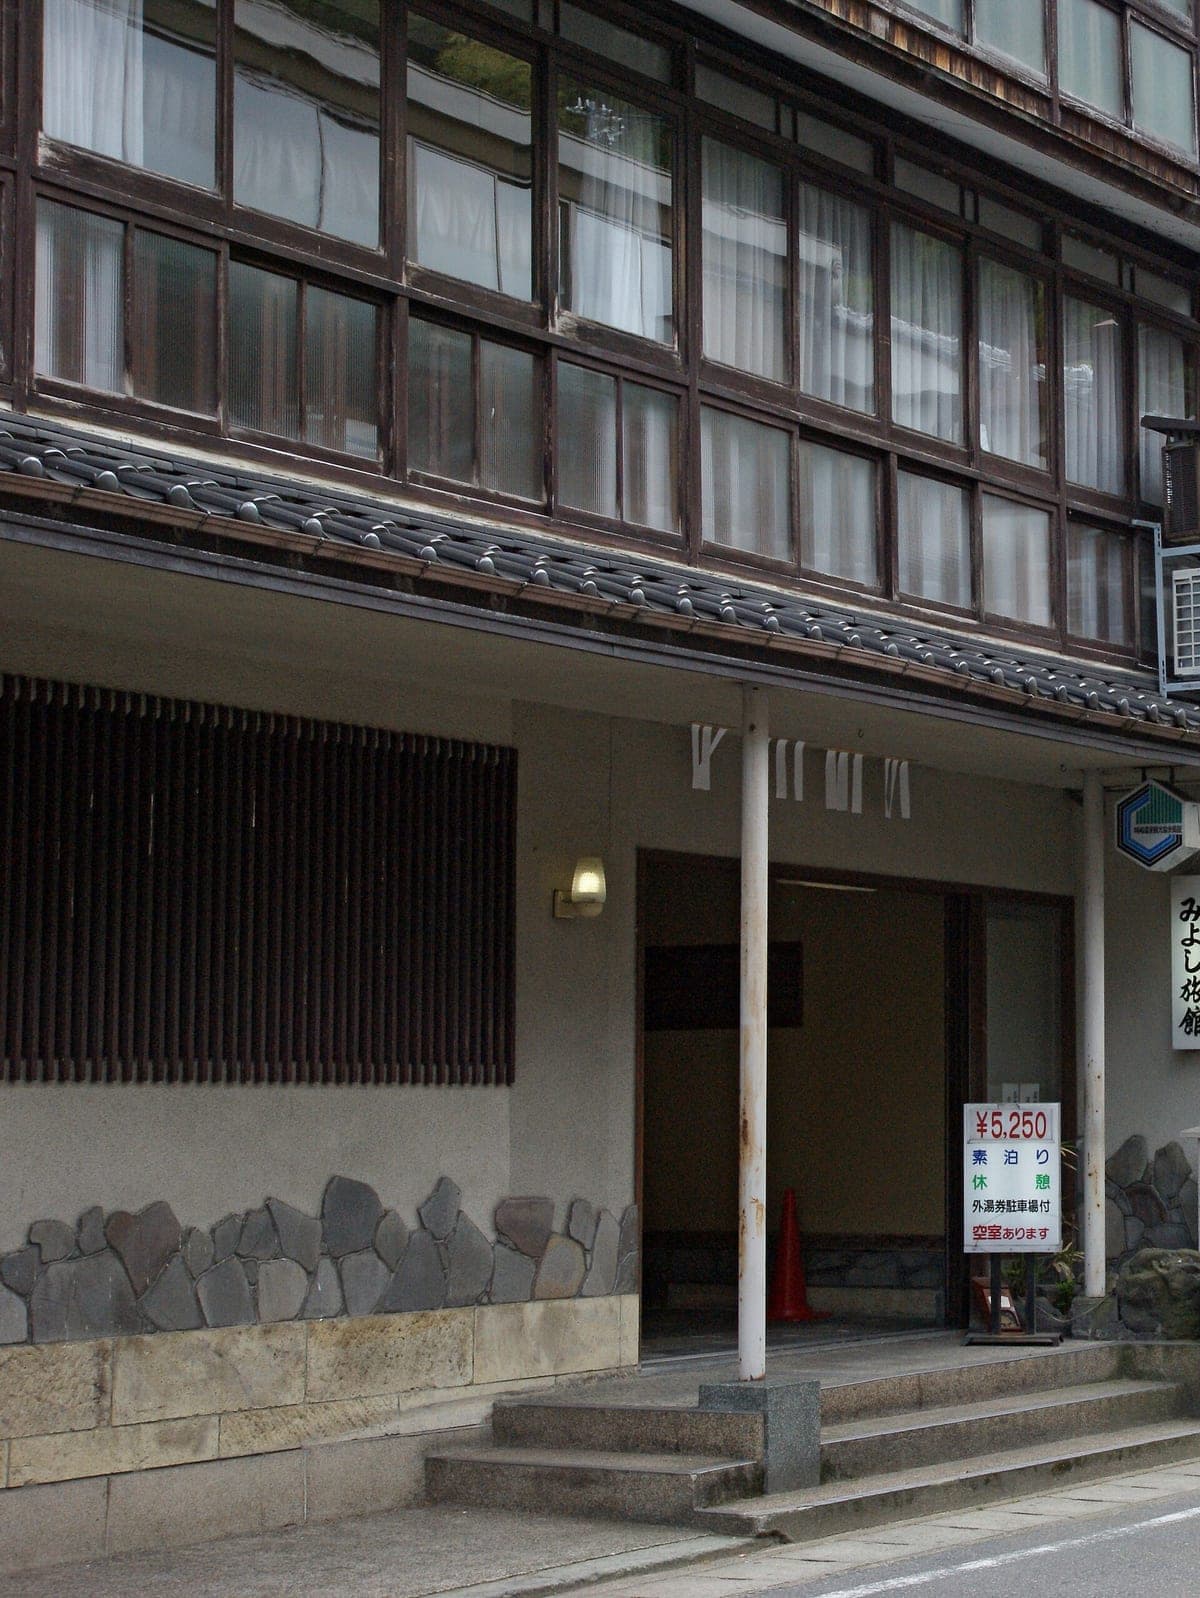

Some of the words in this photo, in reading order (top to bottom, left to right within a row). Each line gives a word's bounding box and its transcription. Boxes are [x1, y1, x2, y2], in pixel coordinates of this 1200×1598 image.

[976, 1111, 1047, 1139] ¥5,250
[972, 1150, 1050, 1165] 素泊り
[972, 1174, 1050, 1190] 休憩
[972, 1199, 1050, 1213] 外湯券駐車場付
[972, 1225, 1050, 1240] 空室あります
